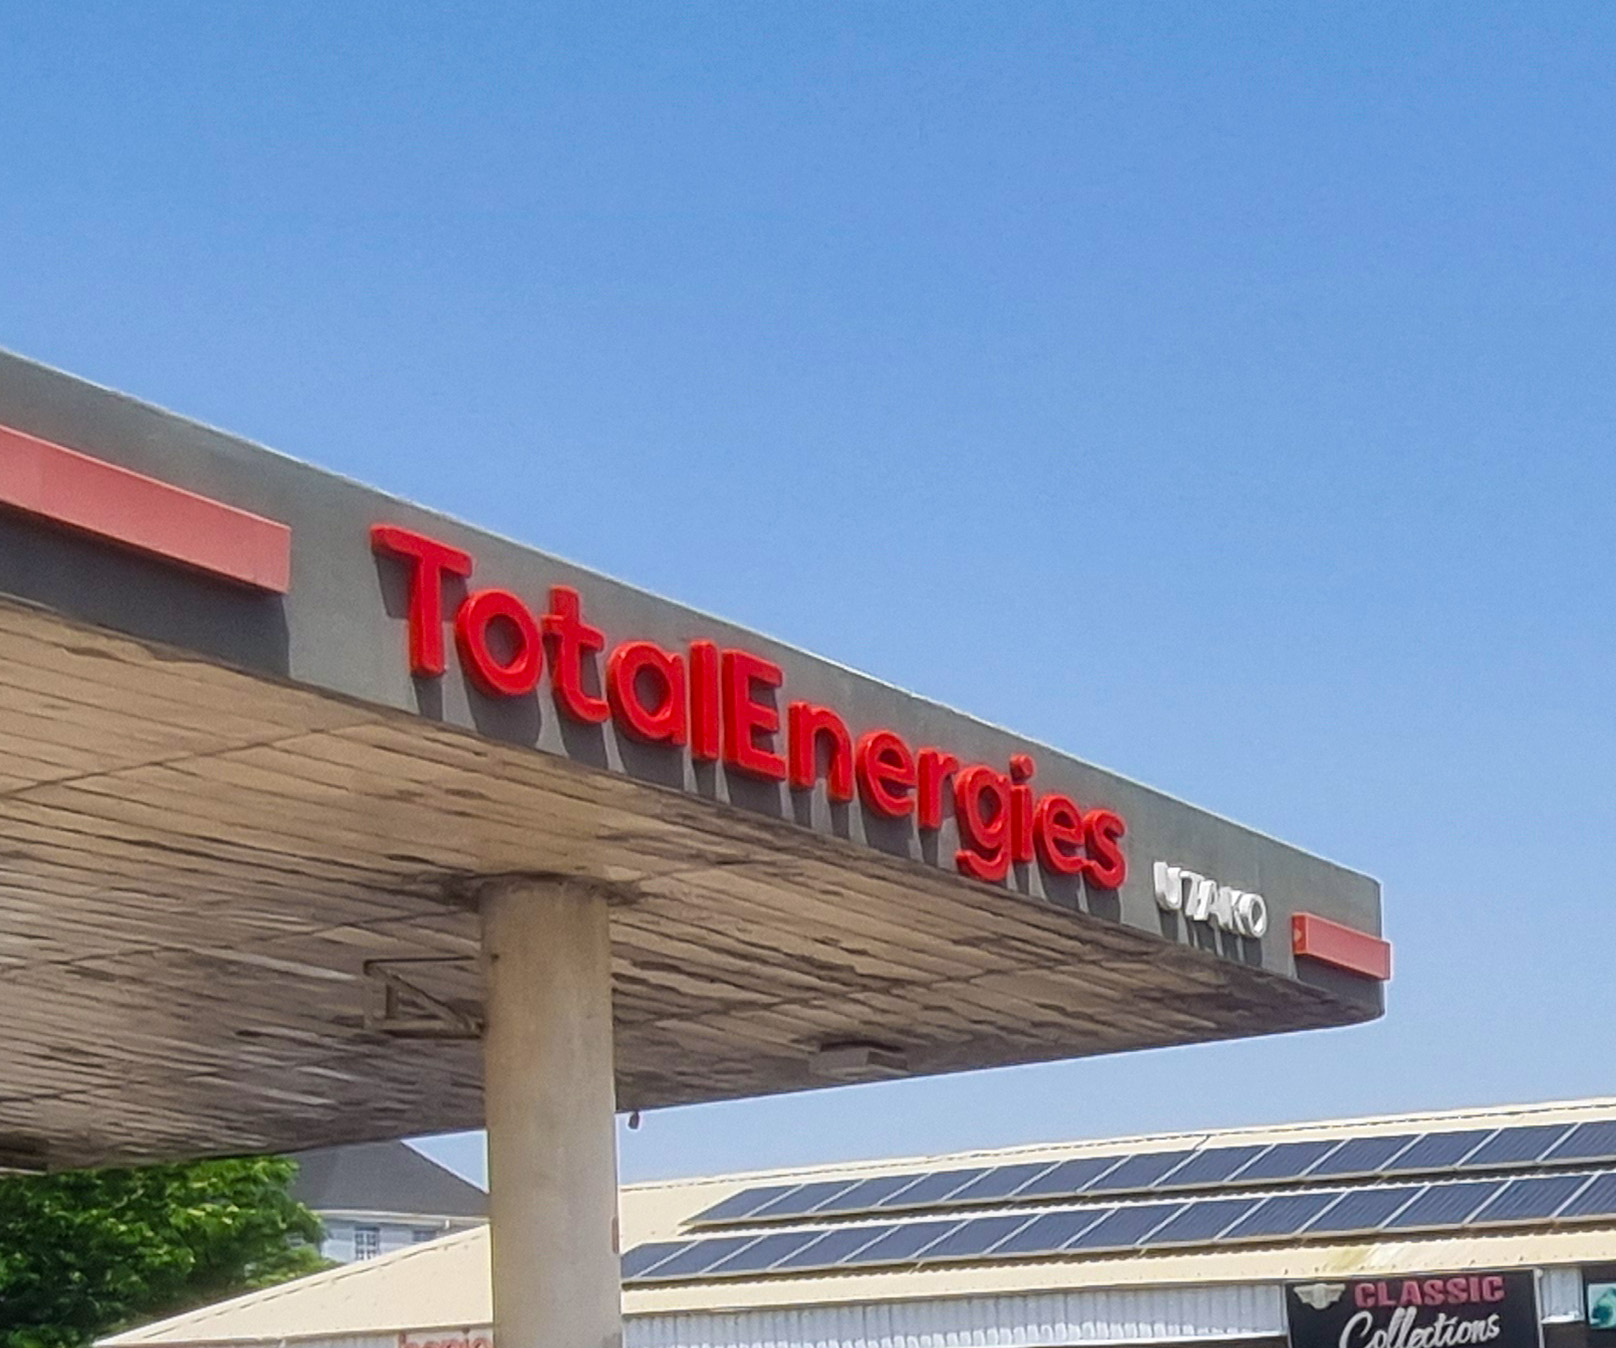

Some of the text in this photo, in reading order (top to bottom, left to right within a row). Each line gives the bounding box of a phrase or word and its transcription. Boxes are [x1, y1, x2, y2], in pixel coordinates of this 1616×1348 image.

[370, 523, 1126, 889] TotalEnergies
[1153, 861, 1267, 938] UTAKO
[1354, 1275, 1505, 1307] CLASSIC
